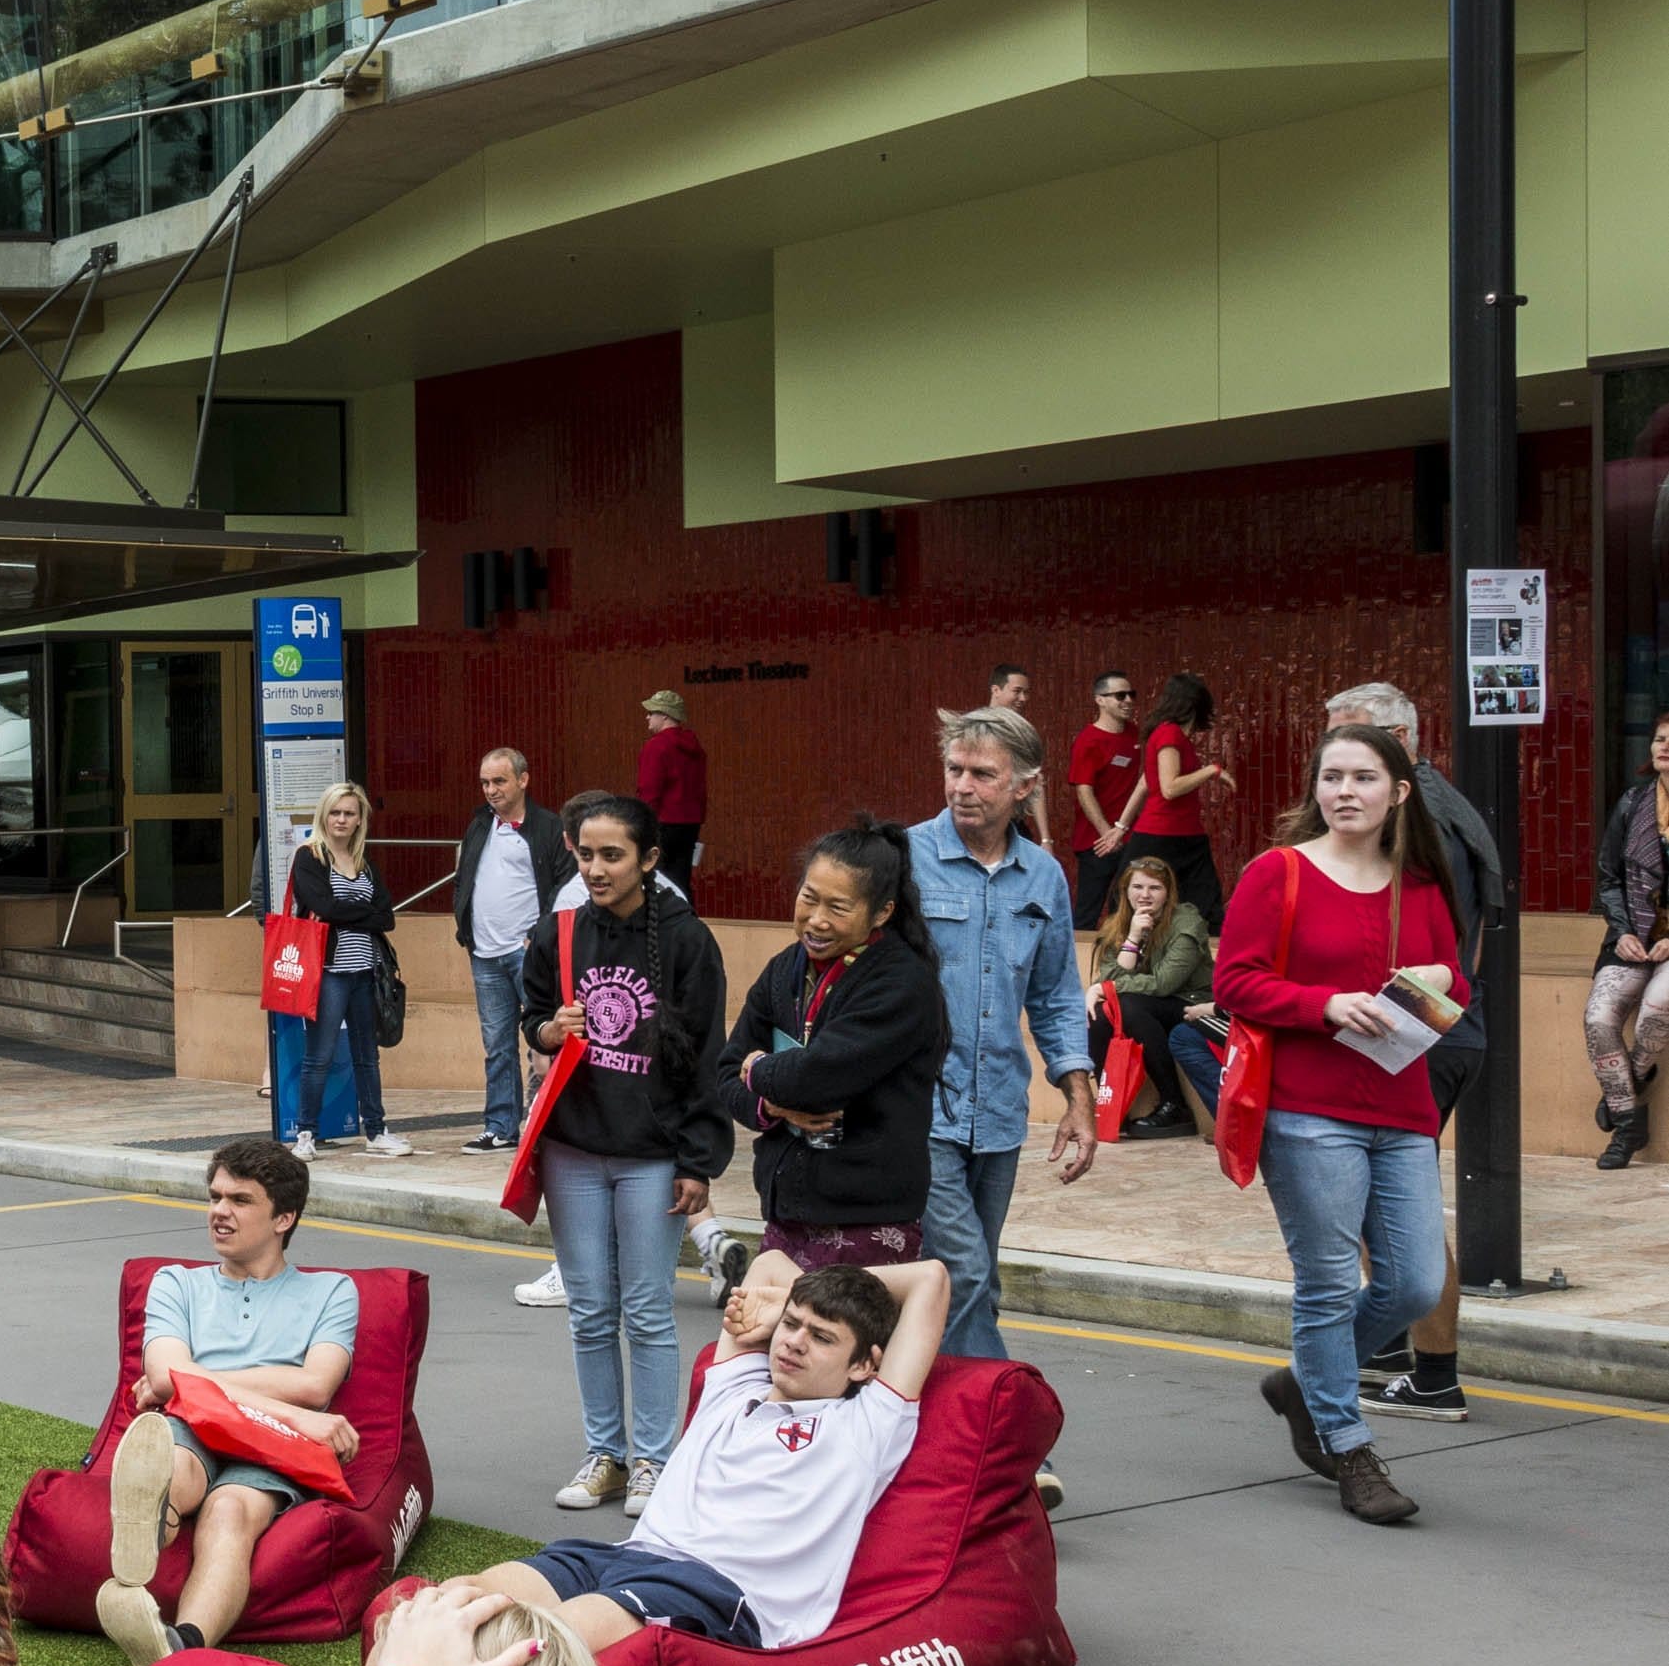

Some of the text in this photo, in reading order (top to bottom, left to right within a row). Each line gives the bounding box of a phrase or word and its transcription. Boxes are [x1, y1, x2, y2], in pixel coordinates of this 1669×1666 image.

[684, 660, 810, 683] Lecture Theatre
[262, 687, 343, 701] Griffith University
[290, 704, 324, 717] Stop B
